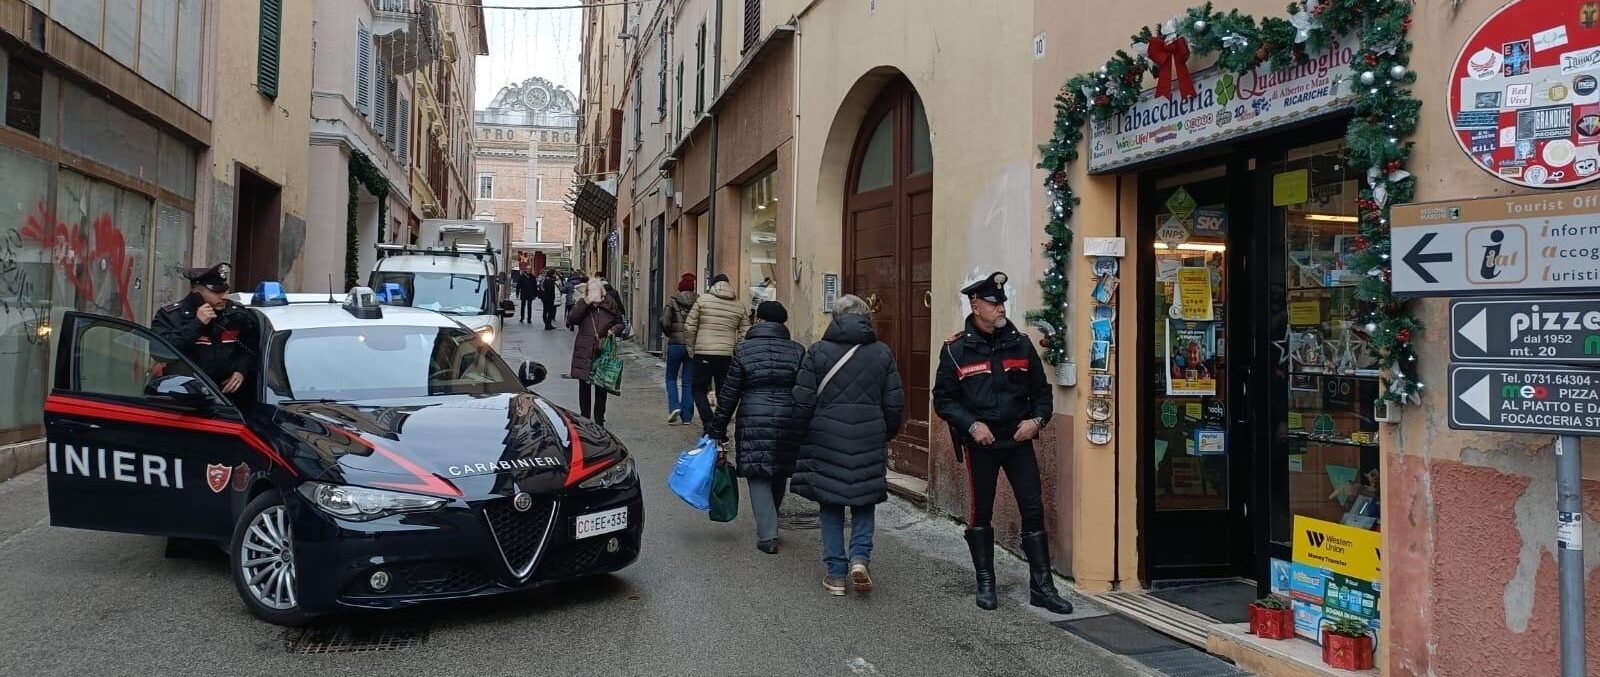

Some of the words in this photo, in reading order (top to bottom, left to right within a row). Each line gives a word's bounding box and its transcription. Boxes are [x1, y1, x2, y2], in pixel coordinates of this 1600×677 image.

[1036, 38, 1043, 56] 10
[1279, 83, 1305, 99] Alberto
[1310, 77, 1331, 91] Mara
[1511, 86, 1528, 95] Red
[1283, 86, 1330, 108] RICARICHE
[1113, 82, 1214, 136] Tabaccheria
[1536, 108, 1571, 130] GRANDINE
[475, 128, 514, 141] TRO
[1472, 143, 1496, 153] KILL
[1505, 199, 1565, 214] Tourist
[1162, 229, 1184, 240] INPS
[1523, 335, 1542, 343] dal
[1544, 335, 1573, 344] 1952
[1510, 347, 1534, 357] mt.
[1538, 346, 1557, 357] 20
[1501, 374, 1521, 384] Tel.
[1524, 374, 1591, 386] 0731.64304
[1559, 388, 1598, 400] PIZZA
[1501, 400, 1519, 410] AL
[1522, 401, 1570, 412] PIATTO
[1574, 402, 1583, 413] E
[1501, 413, 1582, 427] FOCACCERIA
[48, 442, 184, 489] INIERI
[448, 456, 562, 476] CARABINIERI
[1326, 535, 1353, 548] Western
[1325, 543, 1345, 555] Union
[1307, 552, 1325, 563] Money
[1324, 556, 1348, 567] Transfer
